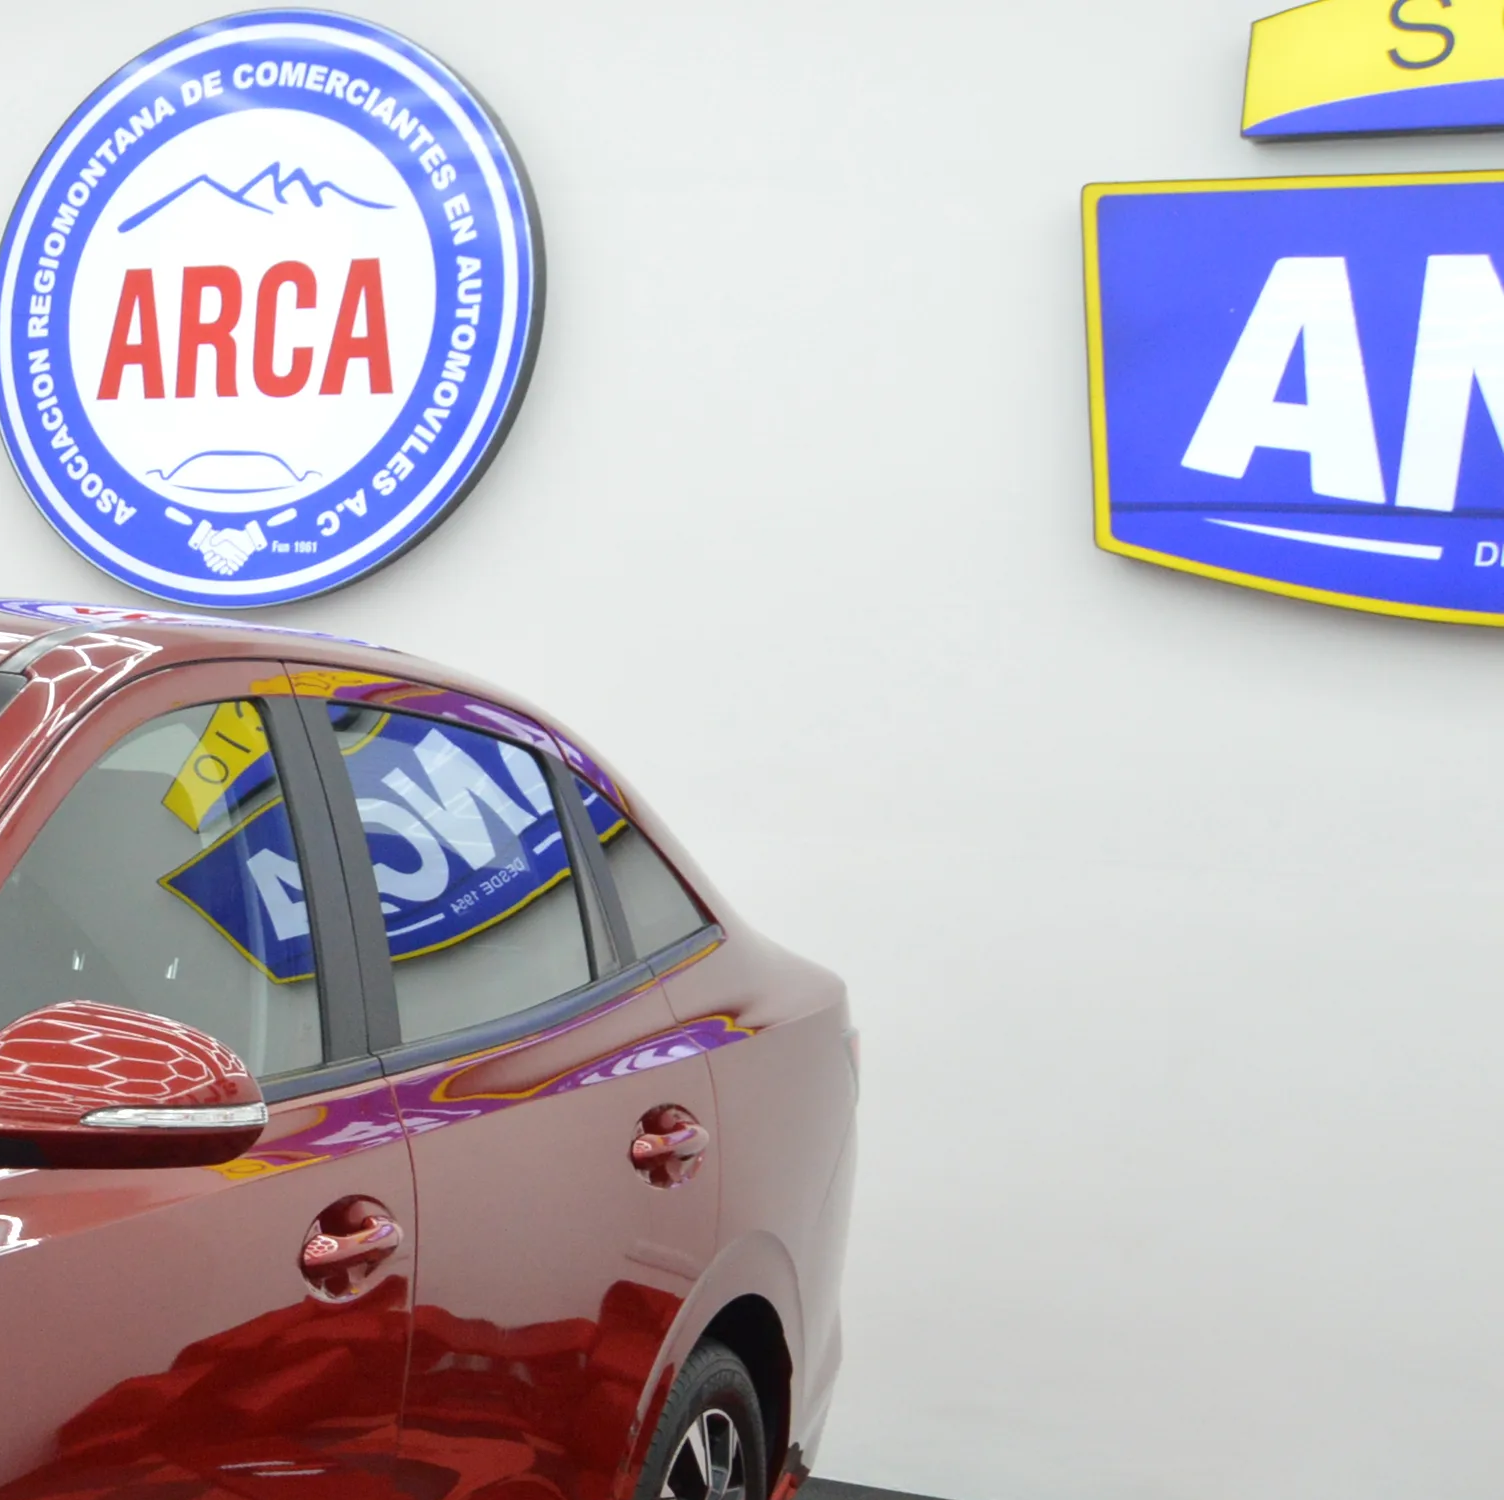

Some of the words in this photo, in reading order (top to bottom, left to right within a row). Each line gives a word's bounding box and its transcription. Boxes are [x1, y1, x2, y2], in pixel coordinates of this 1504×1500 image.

[182, 70, 224, 107] DE
[232, 60, 457, 192] COMERCIANTES
[27, 95, 177, 338] REGIOMONTANA
[442, 191, 478, 246] EN
[96, 257, 394, 400] ARCA
[372, 255, 483, 496] AUTOMOVILES
[28, 347, 138, 526] ASOCIACION
